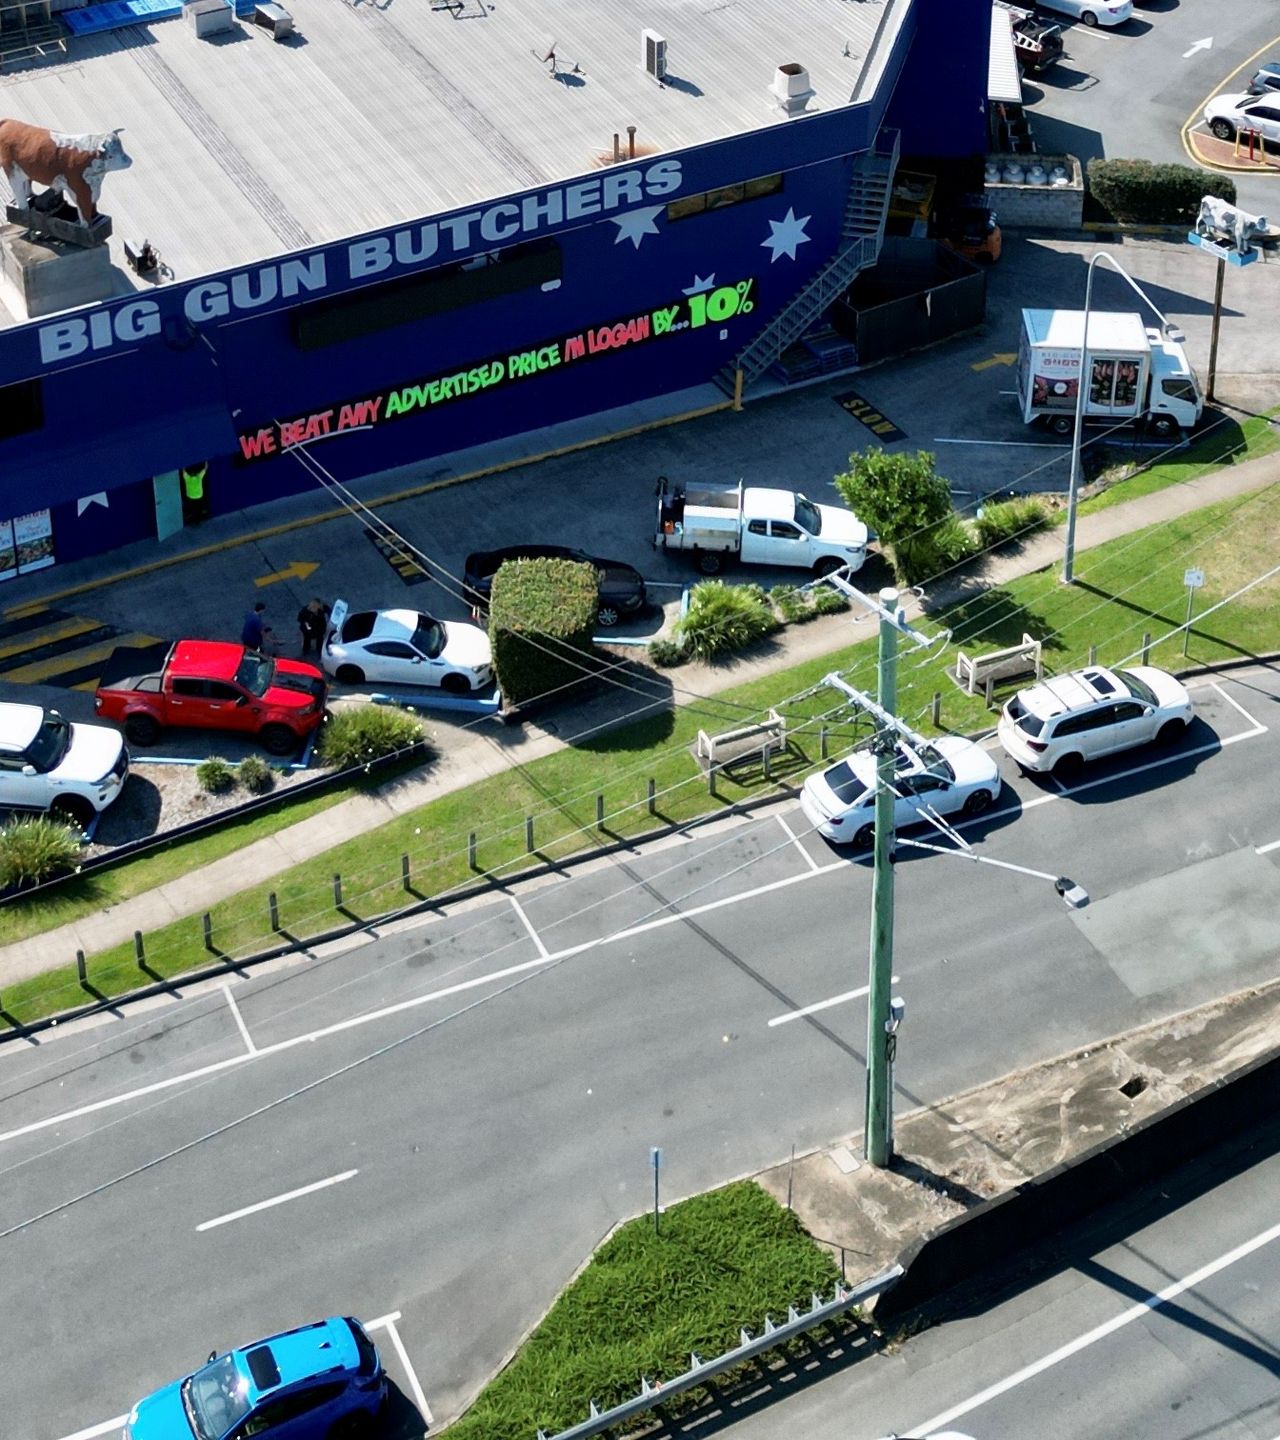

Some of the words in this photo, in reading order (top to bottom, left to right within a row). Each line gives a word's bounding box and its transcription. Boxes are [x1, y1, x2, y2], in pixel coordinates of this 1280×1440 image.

[39, 302, 163, 364] BIG
[183, 253, 328, 323] GUN
[348, 159, 684, 279] BUTCHERS
[238, 429, 277, 460] WE
[279, 412, 331, 448] BEAT
[337, 396, 383, 431] ANY
[384, 359, 505, 418] ADVERTISED
[508, 343, 562, 379] PRICE
[587, 314, 650, 354] LOGAN
[689, 278, 754, 329] 10%
[842, 398, 897, 435] SLOW
